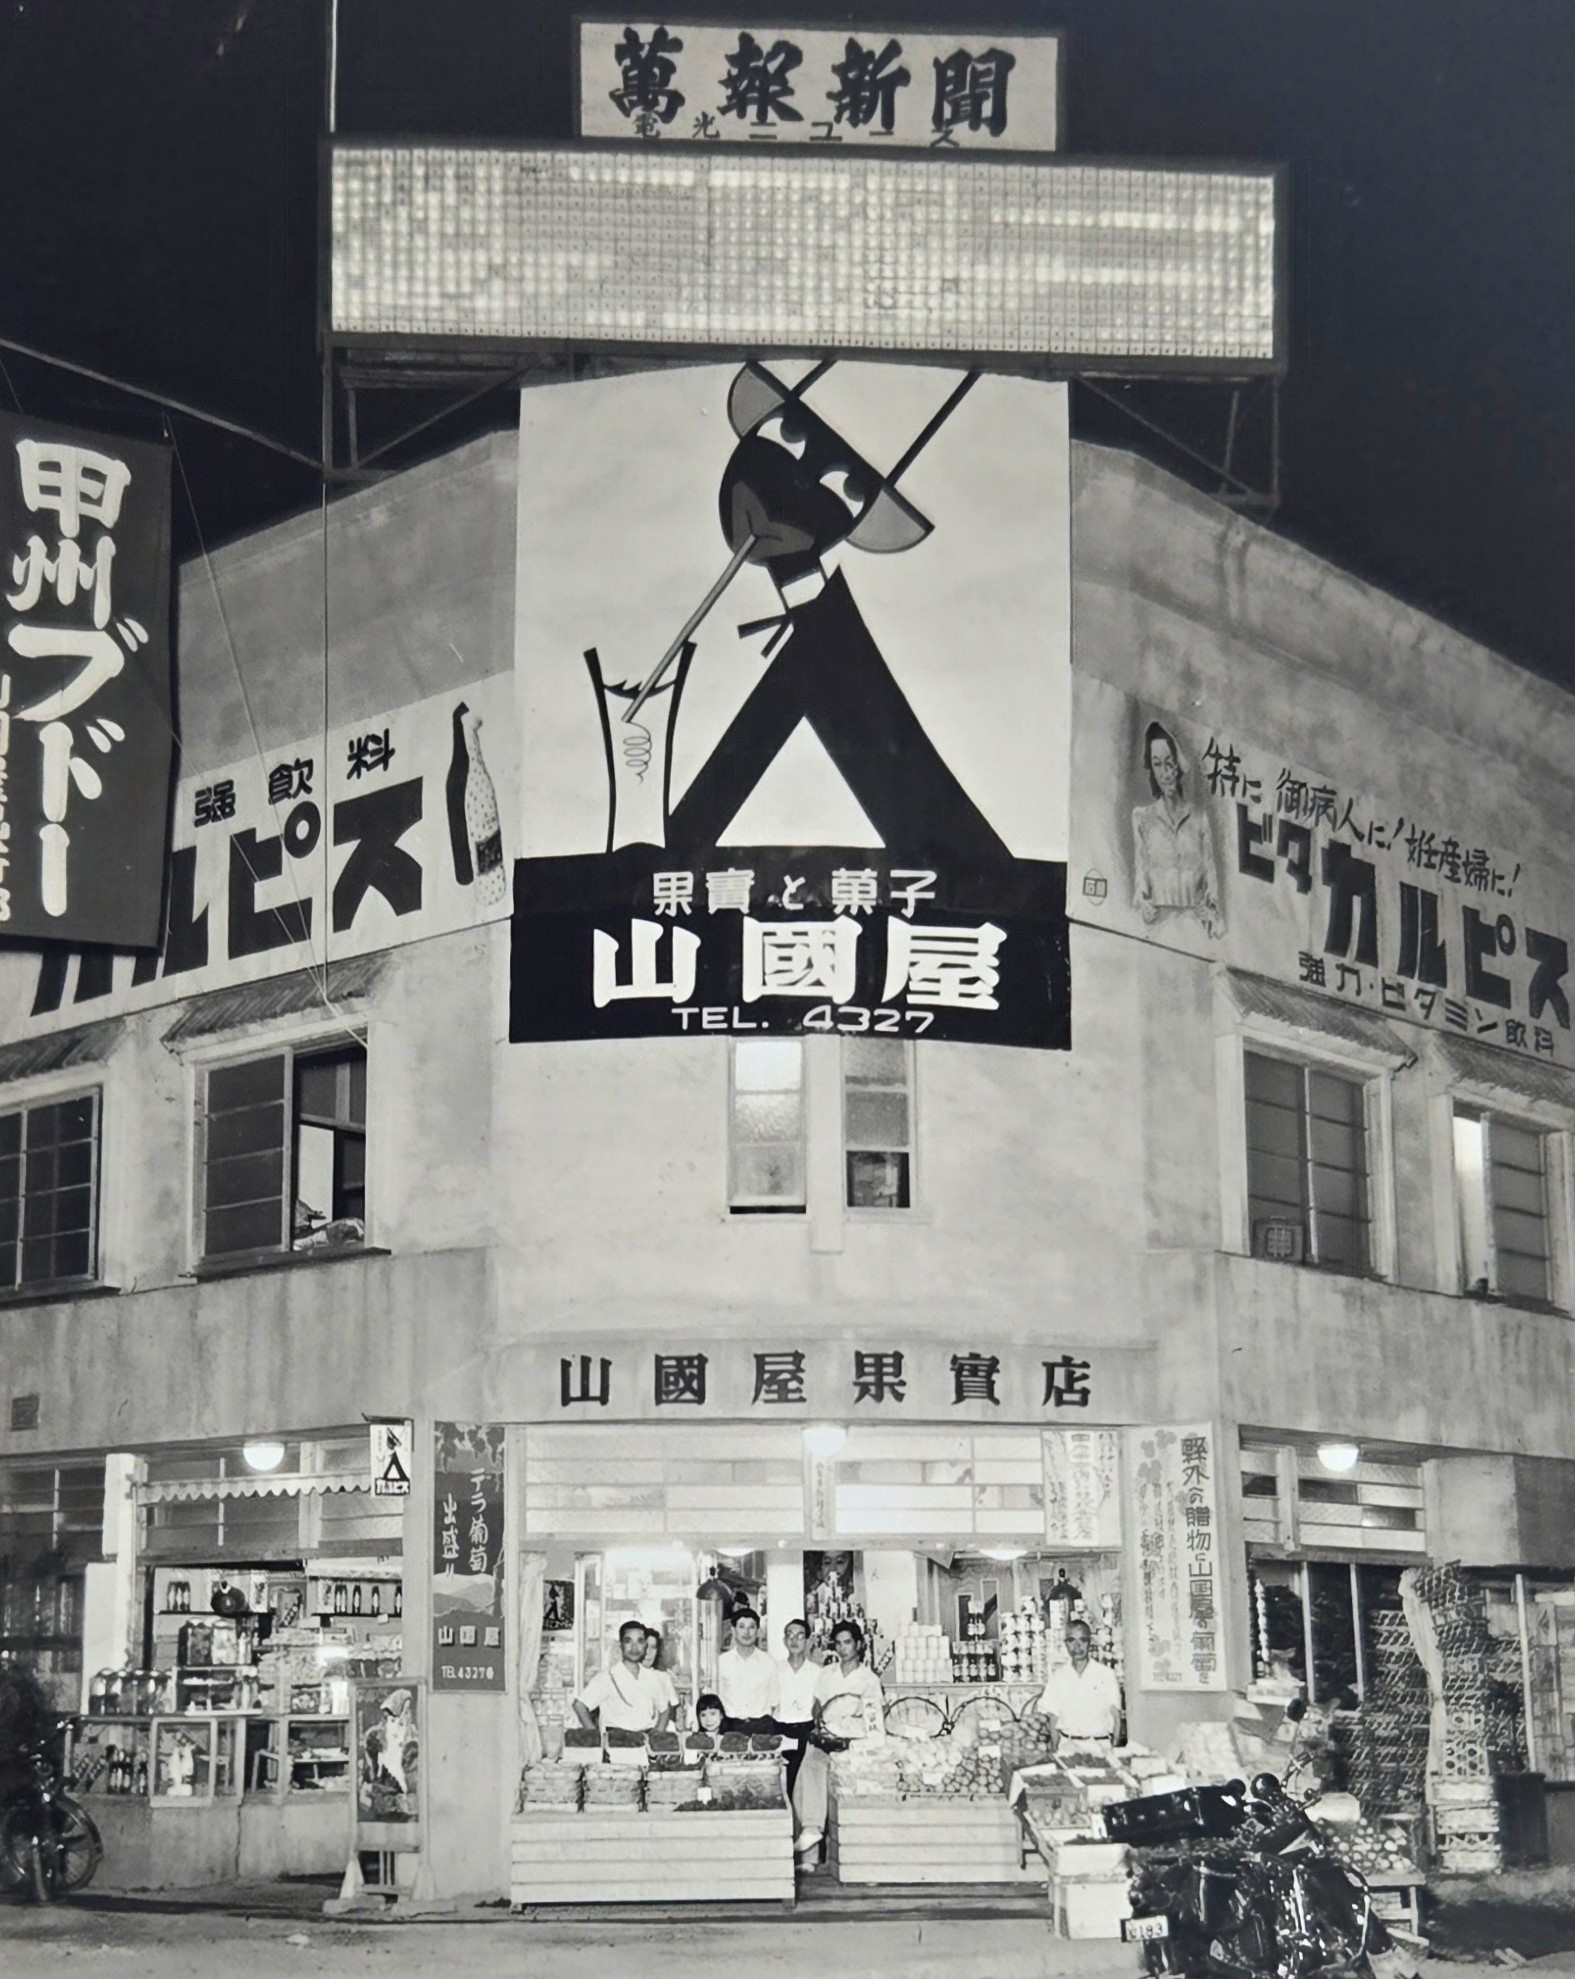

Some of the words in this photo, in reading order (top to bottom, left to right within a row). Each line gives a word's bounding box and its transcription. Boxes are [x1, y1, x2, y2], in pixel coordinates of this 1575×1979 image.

[6, 439, 149, 916] 甲州ブドー
[30, 775, 423, 1016] ルピス
[593, 915, 1008, 1011] 山國屋
[1236, 802, 1571, 1030] ビタカルピス
[672, 1006, 770, 1030] TEL.
[802, 1004, 935, 1033] 4327
[560, 1350, 1093, 1409] 山國屋果實店
